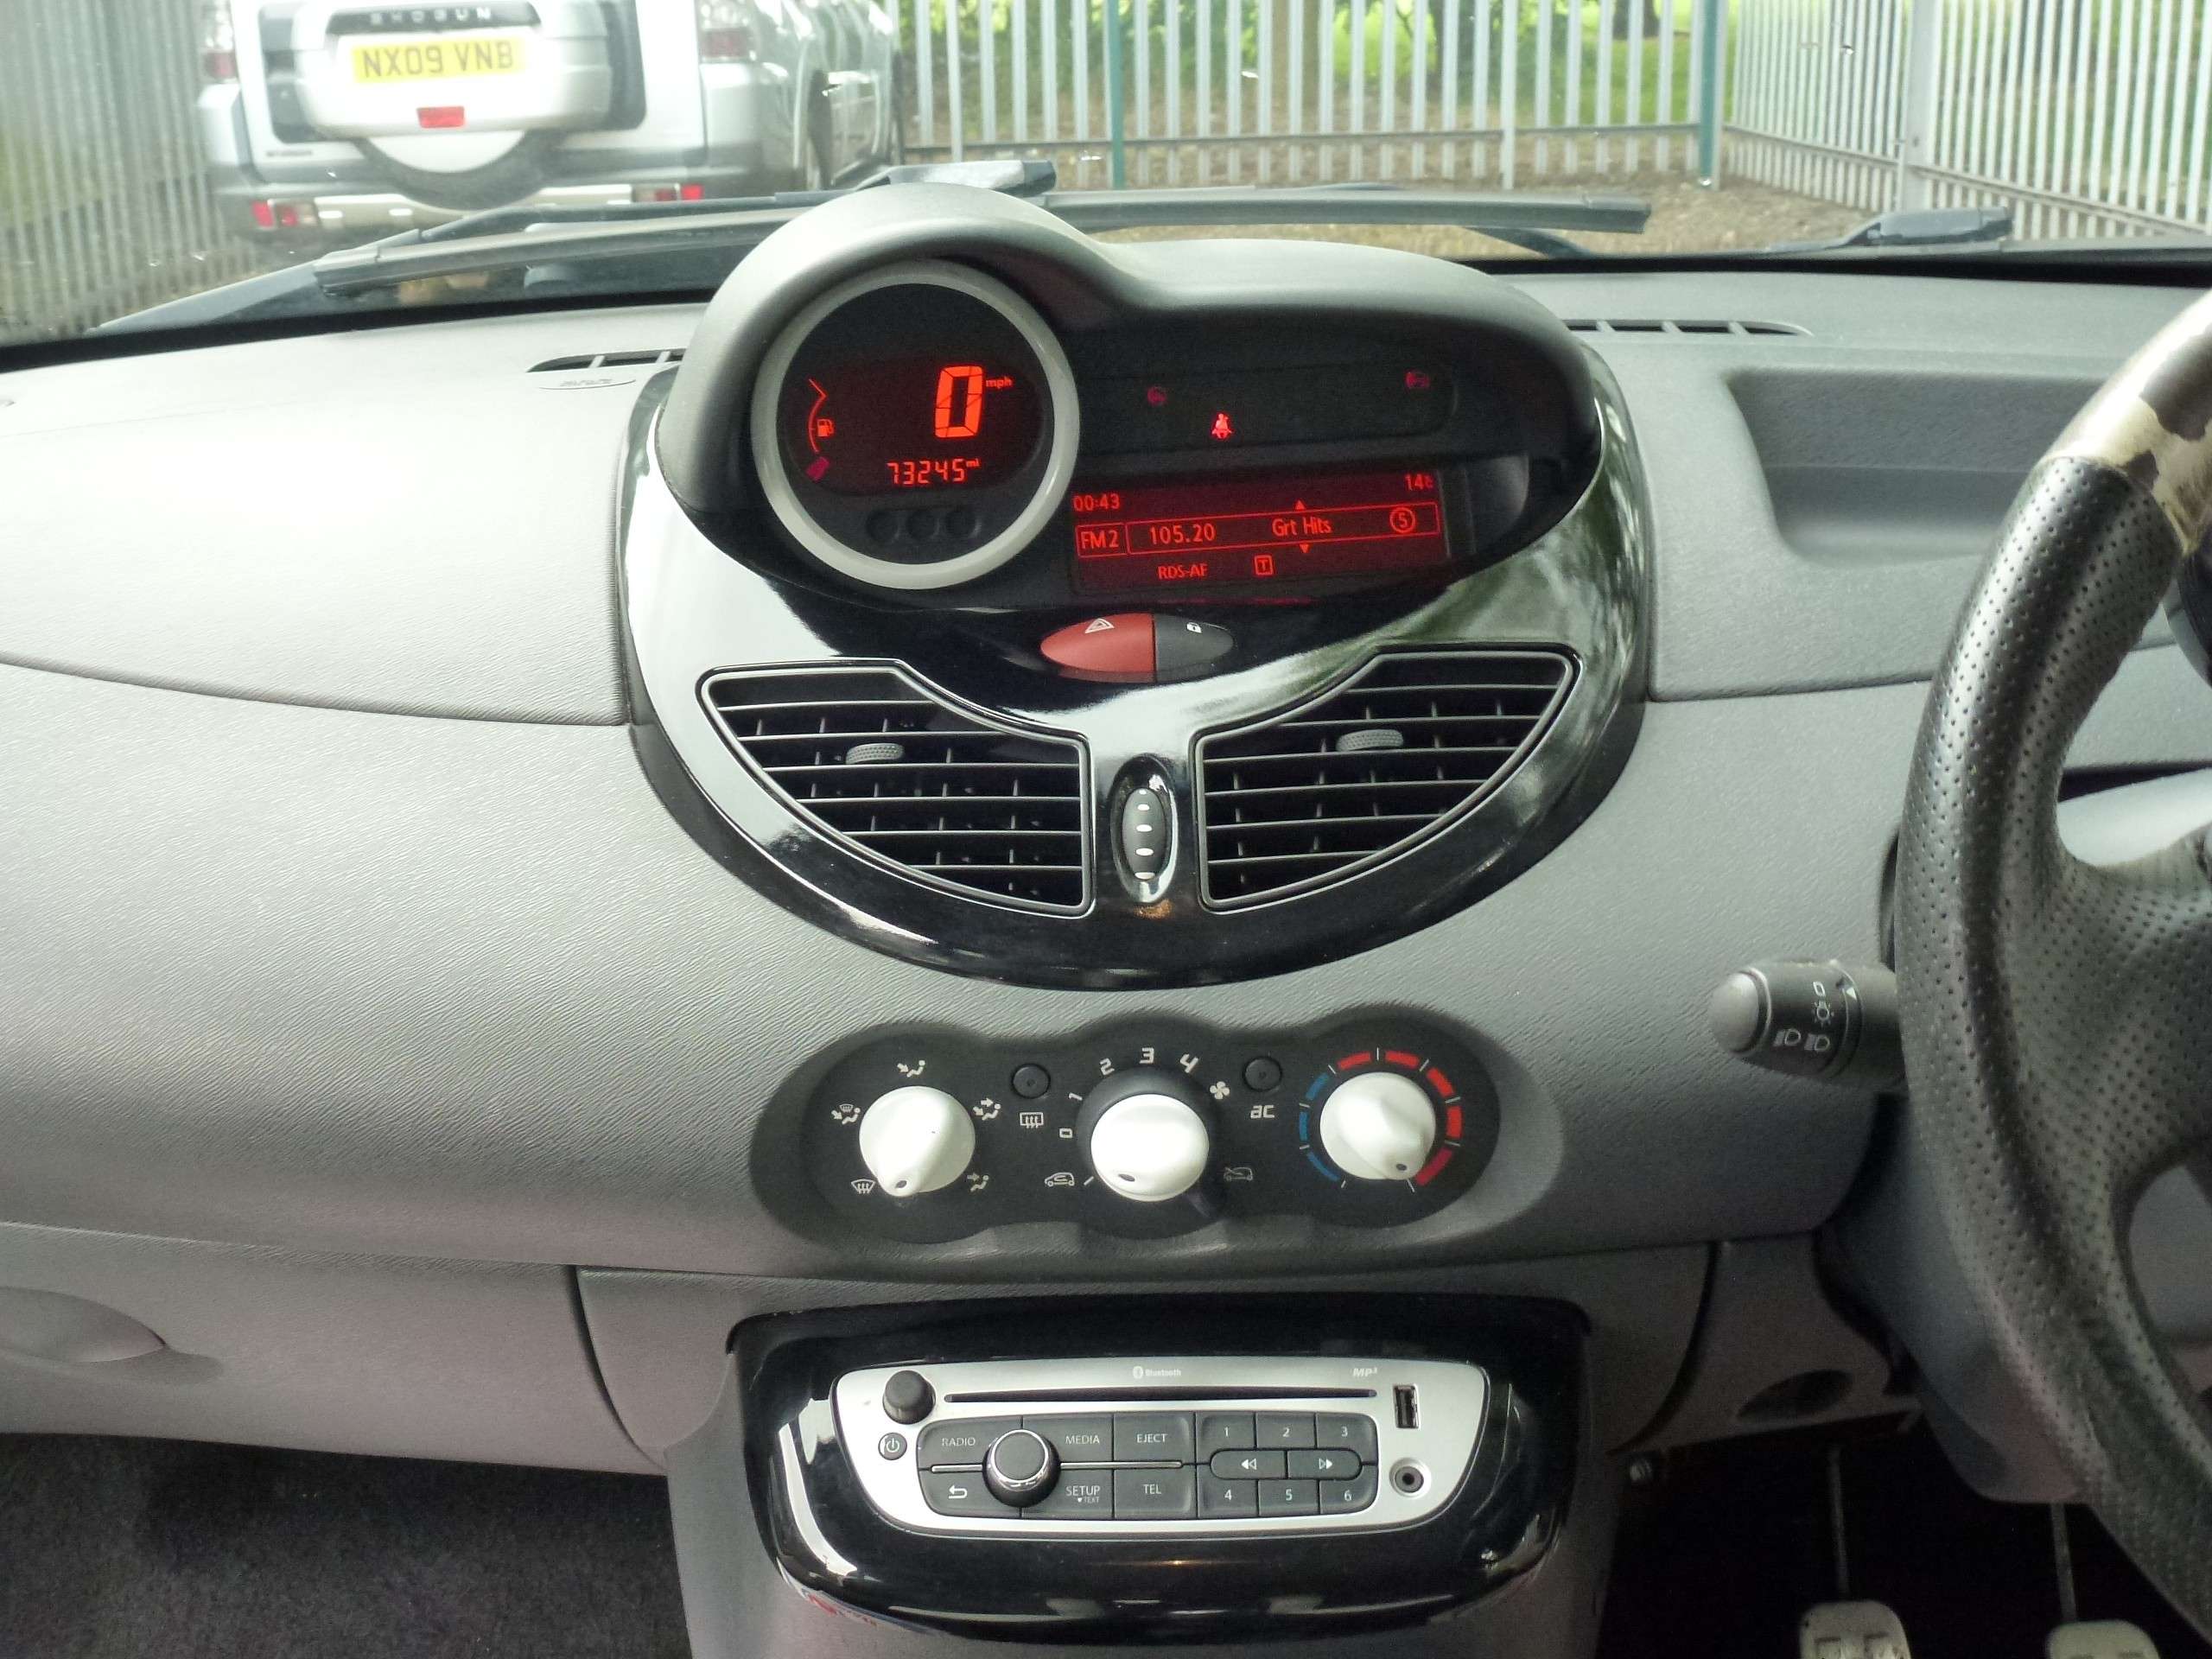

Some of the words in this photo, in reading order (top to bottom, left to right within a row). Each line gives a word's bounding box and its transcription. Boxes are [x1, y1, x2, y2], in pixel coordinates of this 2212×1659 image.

[363, 45, 443, 77] NX09
[454, 41, 513, 71] VNB
[934, 365, 982, 438] 0
[986, 377, 1013, 389] mph
[887, 459, 965, 485] 73245
[1073, 493, 1120, 512] 00:43
[1272, 519, 1297, 537] Grt
[1303, 518, 1332, 535] Hits
[1149, 524, 1216, 545] 105.20
[1158, 563, 1208, 580] RDS-AF
[1139, 1047, 1154, 1065] 3
[1099, 1058, 1115, 1076] 2
[1179, 1053, 1199, 1074] 4
[1250, 1105, 1275, 1119] ac
[1136, 1433, 1168, 1444] EJECT
[1224, 1427, 1230, 1438] 1
[1283, 1427, 1290, 1438] 2
[1342, 1427, 1348, 1438] 3
[941, 1437, 976, 1447] RADIO
[1065, 1434, 1100, 1445] MEDIA
[1065, 1484, 1101, 1497] SETUP
[1143, 1484, 1161, 1495] TEL
[1224, 1490, 1232, 1501] 4
[1286, 1490, 1293, 1501] 5
[1344, 1490, 1352, 1501] 6
[1084, 1495, 1100, 1503] TEXT
